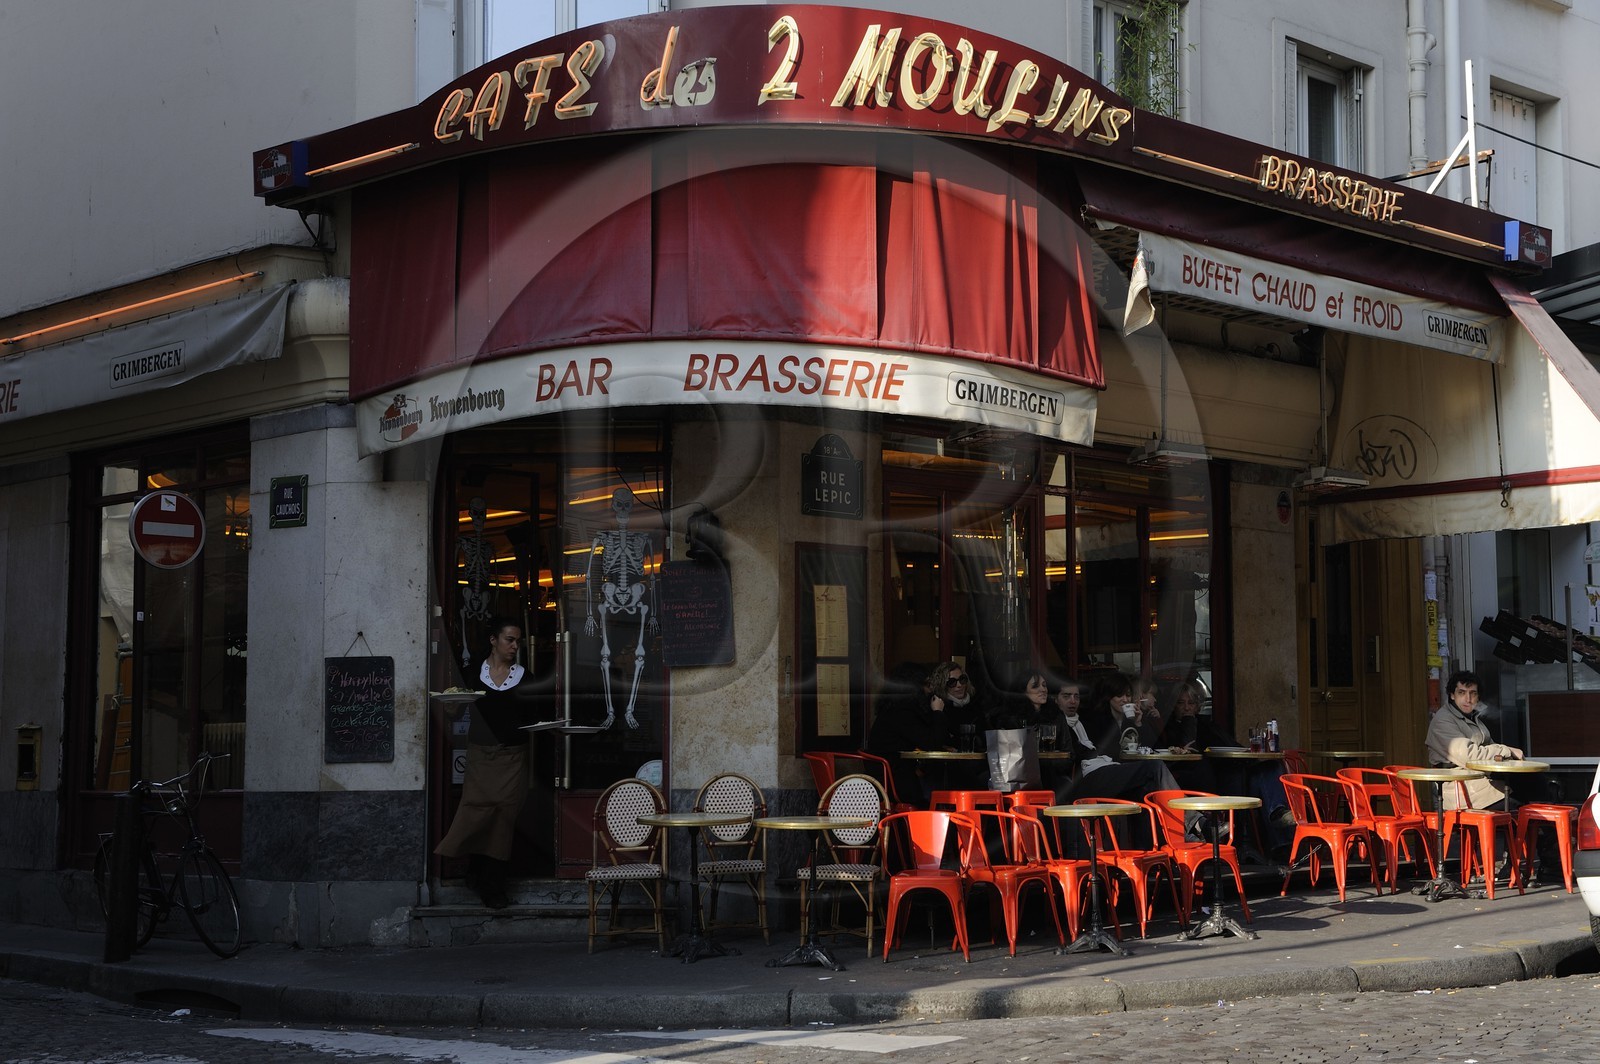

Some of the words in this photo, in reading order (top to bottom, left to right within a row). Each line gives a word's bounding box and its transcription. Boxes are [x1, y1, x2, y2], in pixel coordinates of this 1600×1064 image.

[640, 26, 717, 111] des
[758, 15, 799, 106] 2
[830, 24, 1131, 146] MOULINS
[1257, 154, 1405, 224] BRASSERIE
[1182, 254, 1242, 296] BUFFET
[1251, 272, 1316, 313] CHAUD
[1325, 292, 1344, 320] et
[1353, 295, 1403, 332] FROID
[1427, 314, 1488, 345] GRIMBERGEN
[113, 348, 182, 382] GRIMBERGEN
[535, 357, 613, 402] BAR
[683, 353, 909, 402] BRASSERIE
[428, 386, 505, 423] Kronenbourg
[954, 378, 1059, 418] GRIMBERGEN
[283, 487, 293, 499] RUE
[820, 470, 846, 487] RUE
[275, 502, 301, 516] CAUCHOIS
[815, 488, 851, 506] LEPIC
